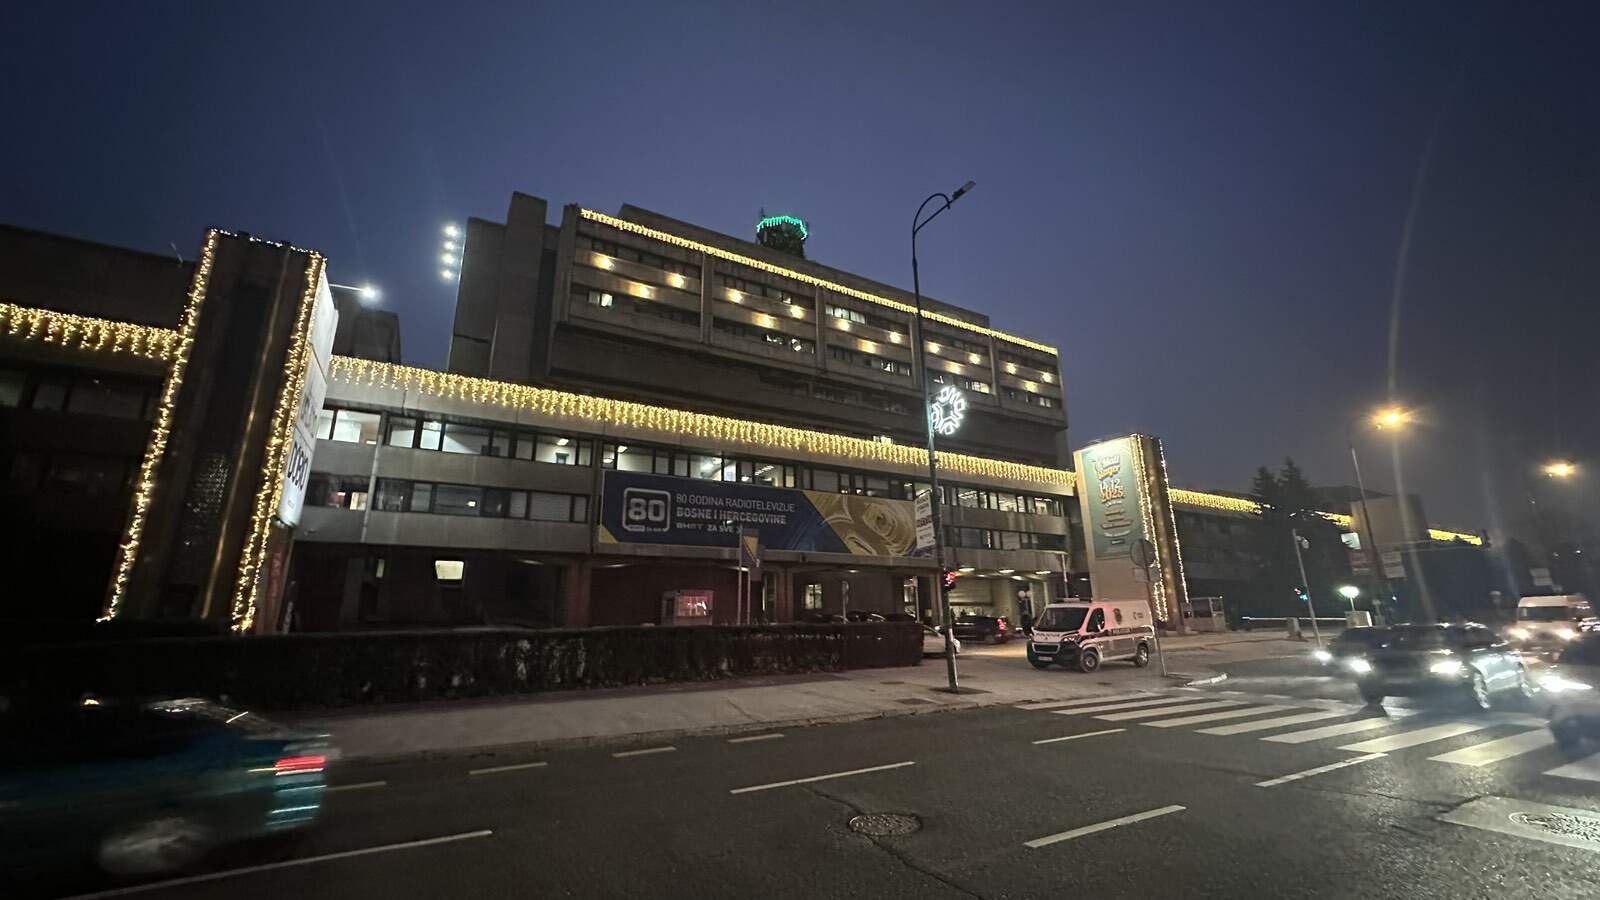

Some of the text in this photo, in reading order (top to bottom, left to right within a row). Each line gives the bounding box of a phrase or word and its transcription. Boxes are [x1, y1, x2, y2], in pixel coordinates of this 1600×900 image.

[628, 498, 666, 522] 80
[676, 493, 795, 513] 80 GODINA RADIOTELEVIZIJE
[676, 507, 712, 519] BOSNE
[719, 510, 787, 525] HERCEGOVINE
[707, 524, 718, 532] ZA
